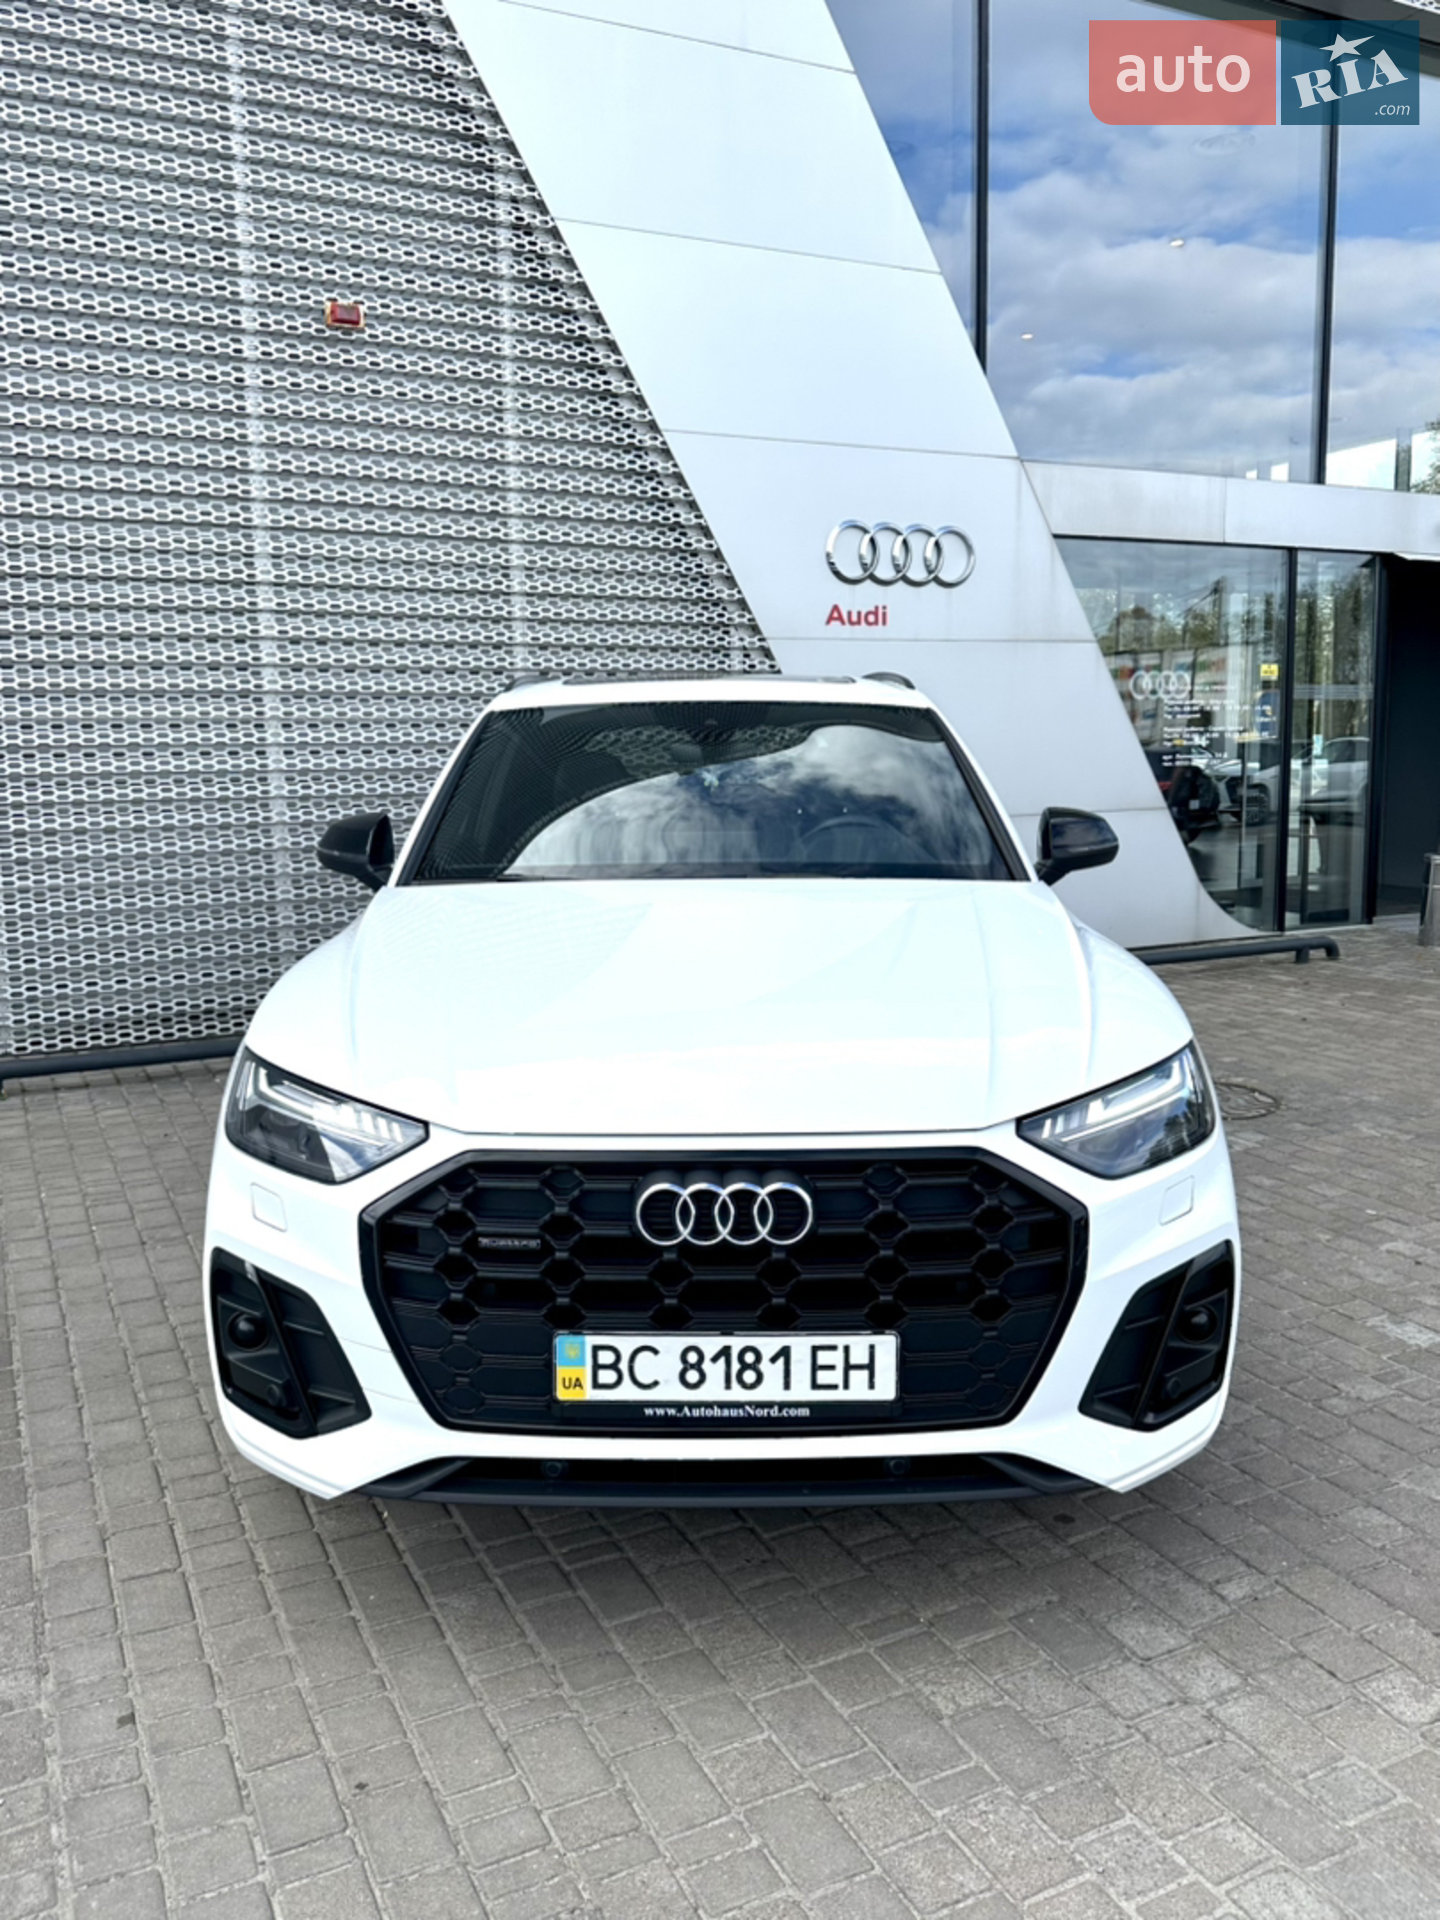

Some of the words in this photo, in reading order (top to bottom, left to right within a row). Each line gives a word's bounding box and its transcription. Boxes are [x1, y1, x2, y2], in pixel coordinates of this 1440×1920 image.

[825, 603, 888, 627] Audi
[591, 1344, 661, 1391] BC
[678, 1344, 792, 1391] 8181
[810, 1344, 876, 1391] EH
[562, 1376, 584, 1391] UA
[643, 1404, 811, 1418] www.AutohausNord.com
